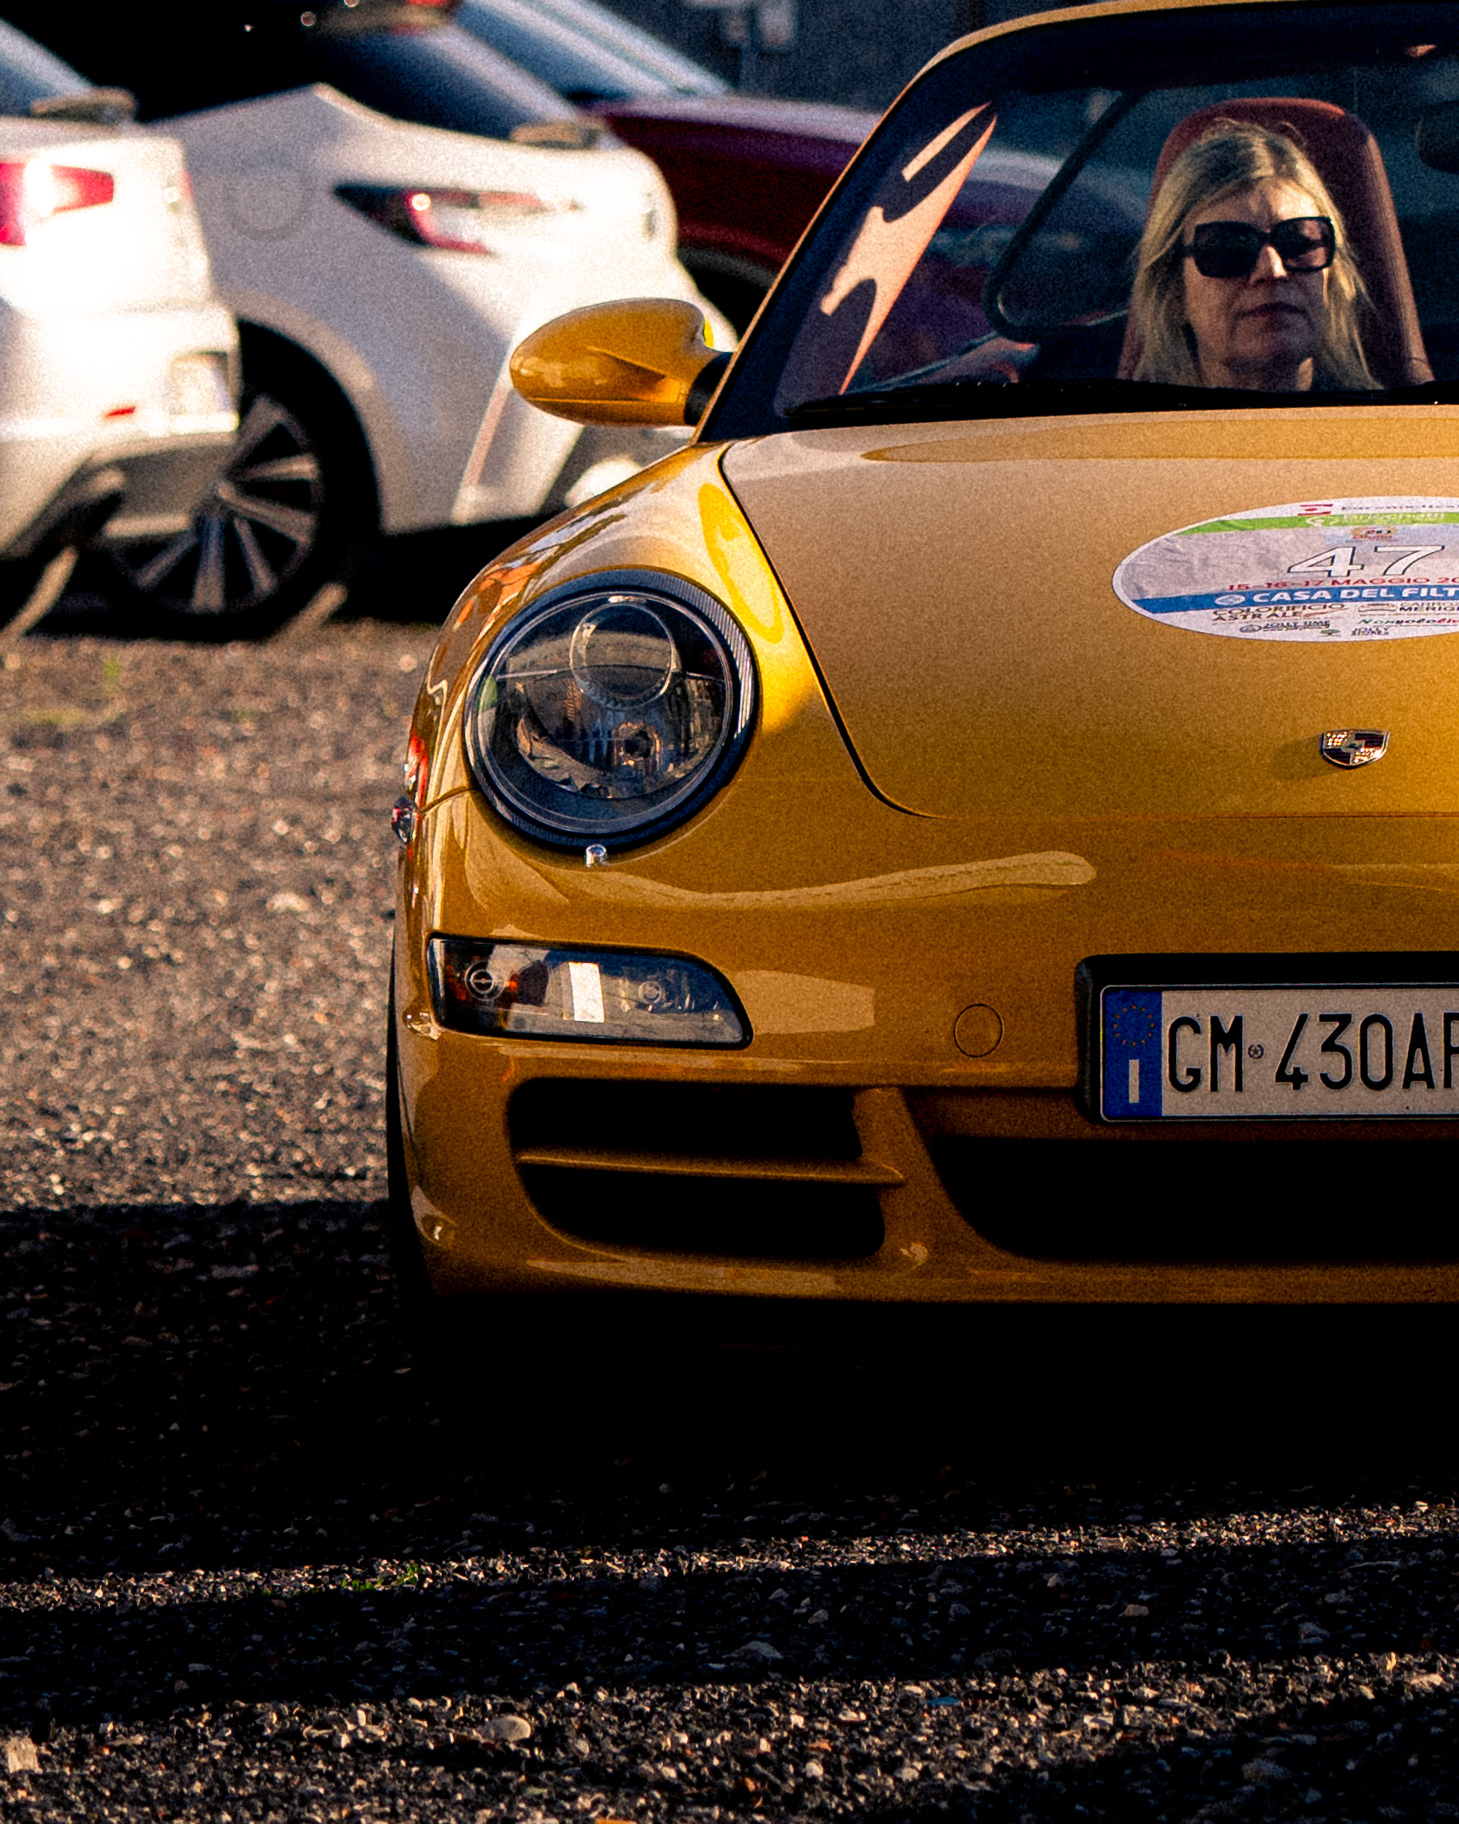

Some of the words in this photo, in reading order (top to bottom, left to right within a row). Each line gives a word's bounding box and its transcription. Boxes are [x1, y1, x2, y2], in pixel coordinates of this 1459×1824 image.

[1287, 545, 1445, 577] 47
[1228, 579, 1325, 591] 15-16-17
[1331, 576, 1431, 586] MAGGIO
[1252, 589, 1332, 603] CASA
[1340, 588, 1396, 599] DEL
[1211, 611, 1304, 622] ASTRALE
[1212, 602, 1346, 616] COLORIFICIO
